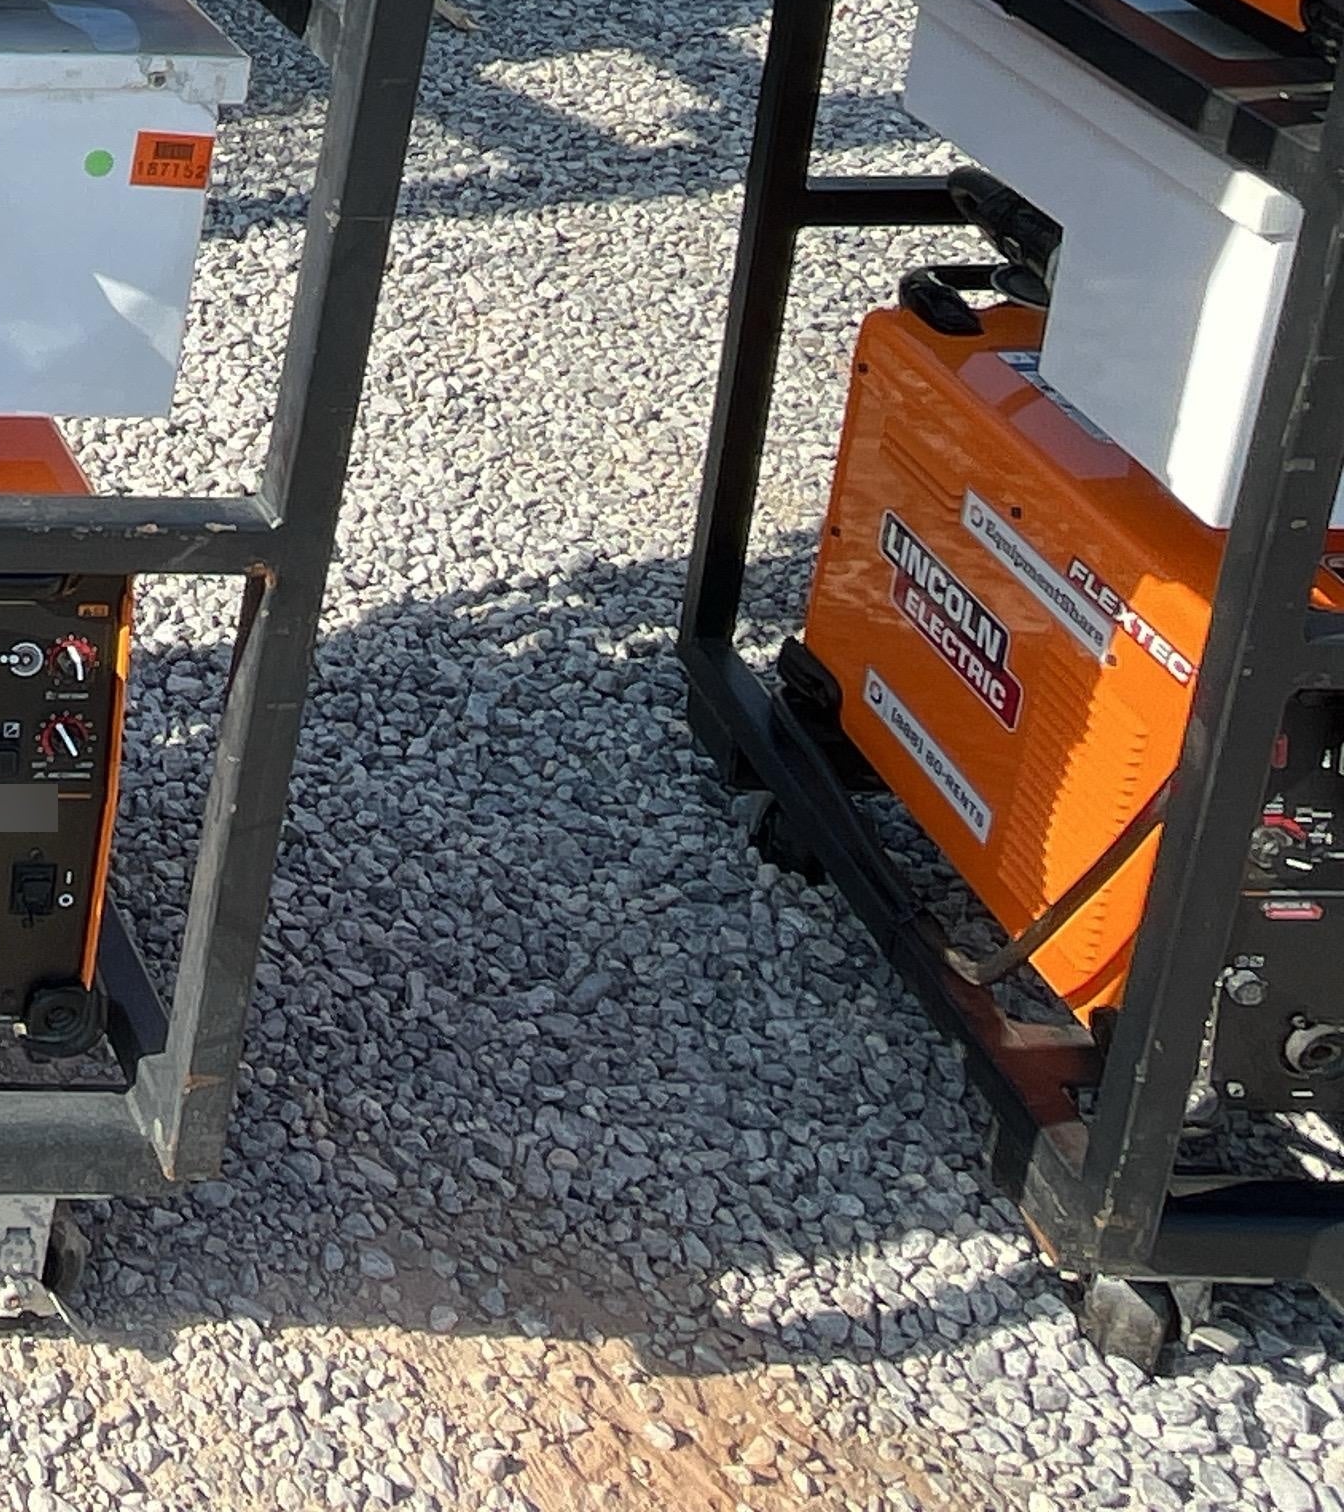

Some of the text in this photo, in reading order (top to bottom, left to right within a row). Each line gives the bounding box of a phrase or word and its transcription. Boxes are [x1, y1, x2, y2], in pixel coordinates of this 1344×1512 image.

[886, 522, 1003, 663] LINCOLN
[904, 591, 1007, 711] ELECTRIC
[1069, 560, 1194, 685] FLEXTEC
